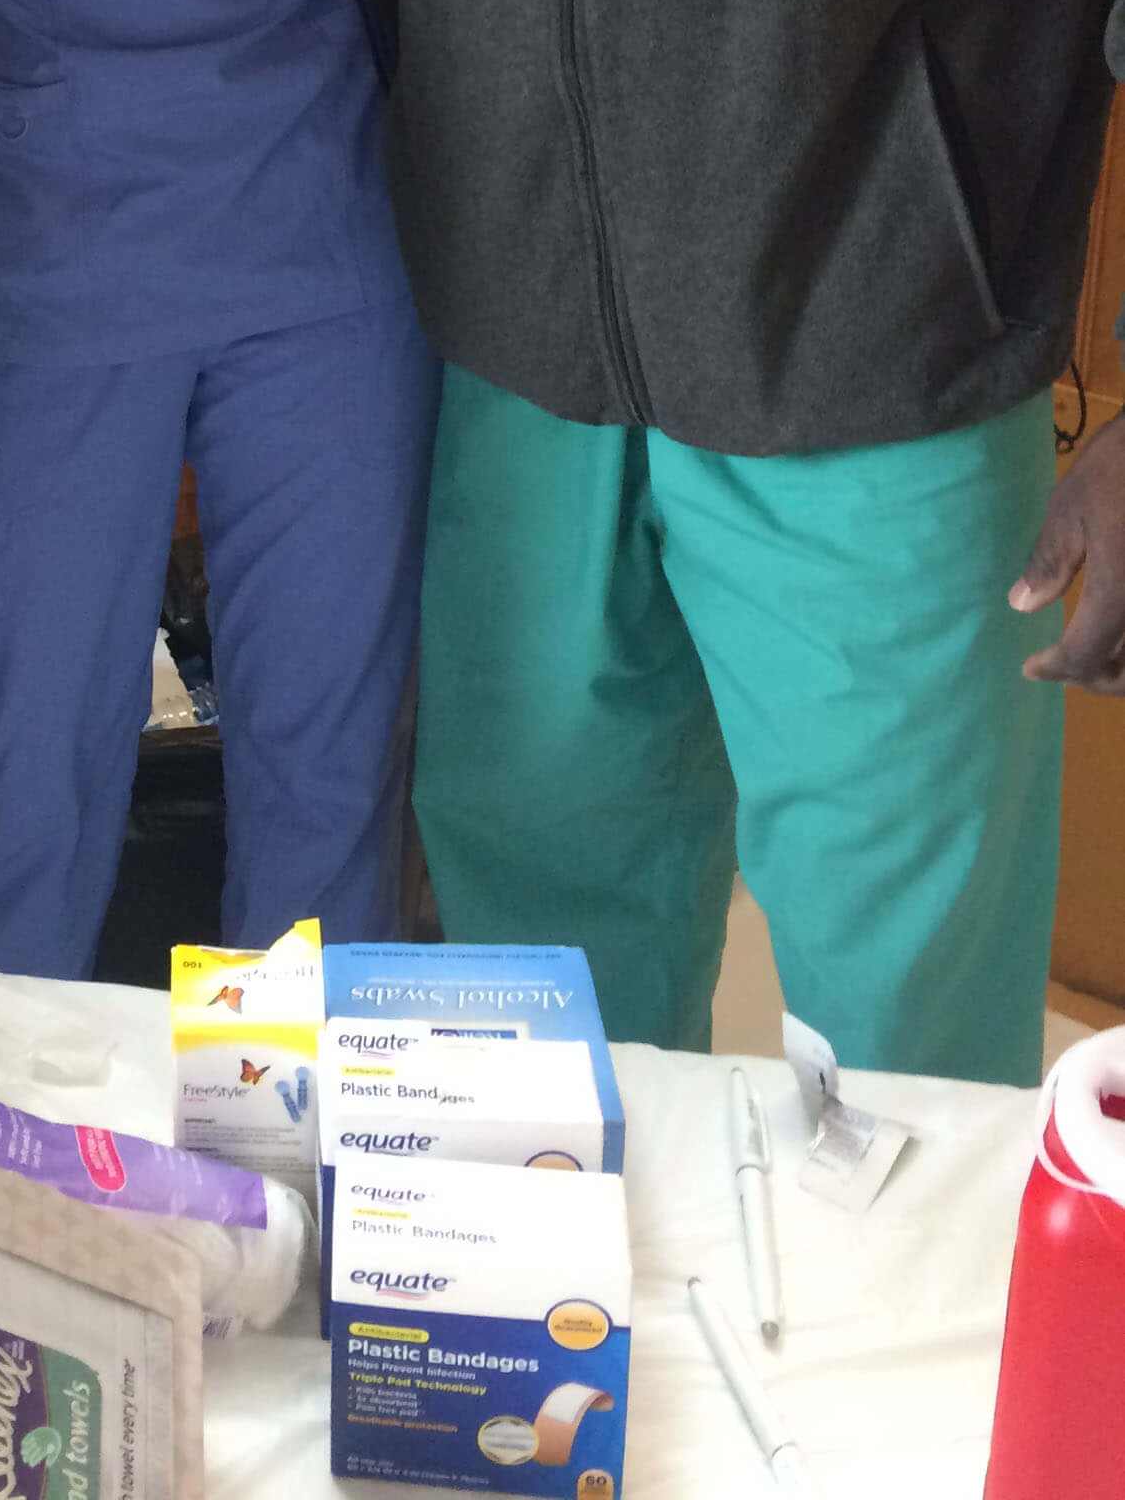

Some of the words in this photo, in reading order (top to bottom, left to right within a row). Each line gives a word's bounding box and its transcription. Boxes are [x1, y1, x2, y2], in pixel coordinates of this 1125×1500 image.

[350, 986, 445, 1007] Swabs
[458, 988, 574, 1010] Alcohol
[338, 1032, 410, 1053] equate
[183, 1084, 247, 1100] FreeStyle
[341, 1082, 392, 1097] Plastic
[340, 1131, 433, 1154] equate
[350, 1184, 427, 1201] equate
[352, 1219, 404, 1235] Plastic
[412, 1225, 498, 1245] Bandages
[350, 1268, 449, 1292] equate
[347, 1338, 421, 1362] Plastic
[427, 1347, 541, 1373] Bandages
[347, 1357, 380, 1371] Helps
[381, 1361, 424, 1375] Prevent
[426, 1365, 477, 1380] Infection
[349, 1372, 385, 1385] Triple
[386, 1375, 412, 1388] Pad
[415, 1379, 487, 1396] Technology
[62, 1379, 91, 1464] towels
[121, 1400, 138, 1445] every
[119, 1445, 135, 1497] towel
